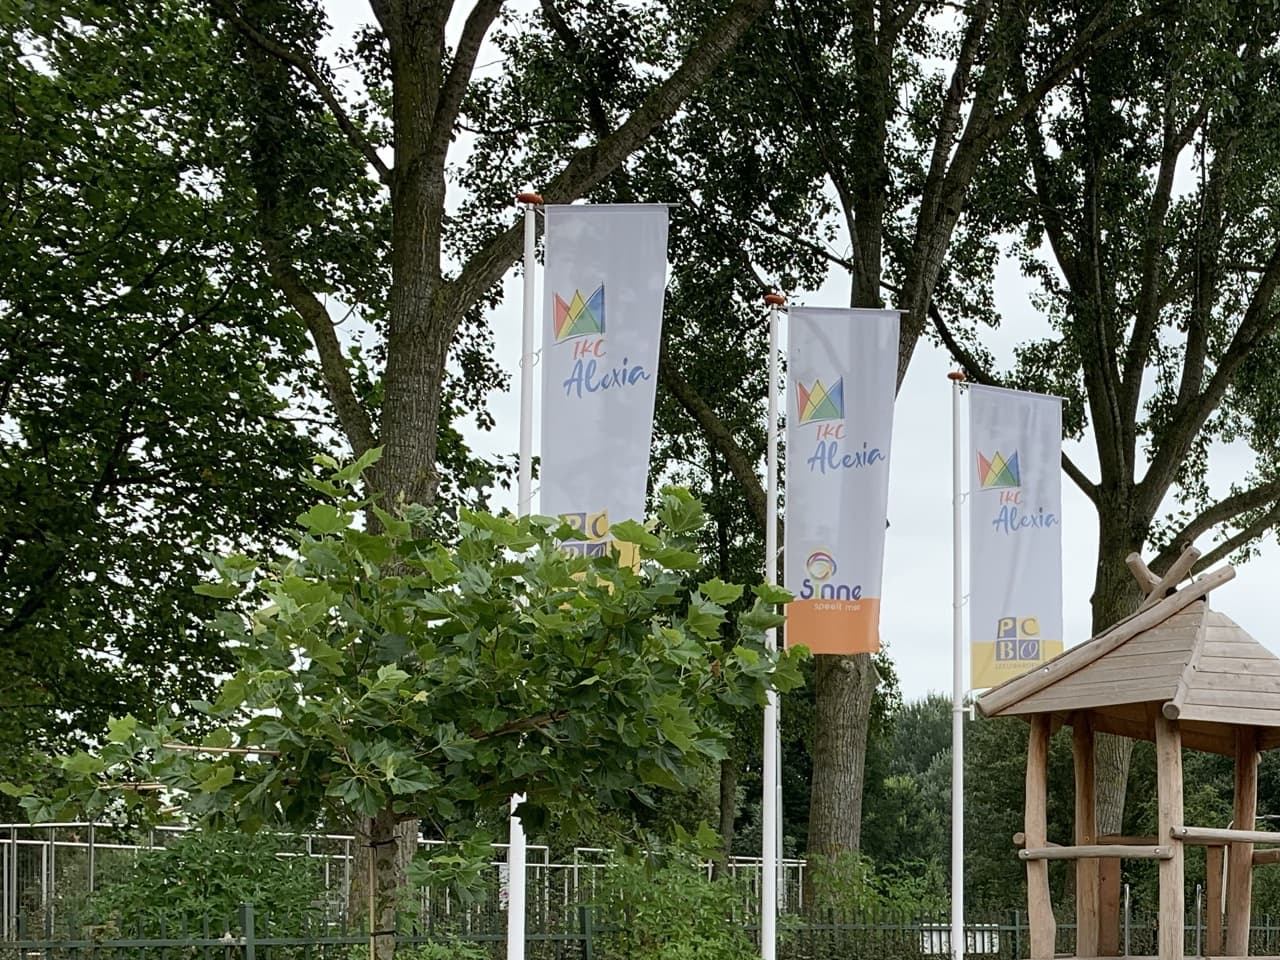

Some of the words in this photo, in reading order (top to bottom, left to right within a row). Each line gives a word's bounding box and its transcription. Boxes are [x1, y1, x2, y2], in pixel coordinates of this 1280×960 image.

[573, 339, 607, 360] IKC
[563, 357, 651, 399] Alexia
[816, 424, 847, 441] IKC
[807, 440, 886, 475] Alexia
[1000, 491, 1023, 505] IKC
[992, 505, 1059, 535] Alexia
[800, 578, 862, 601] Sinne
